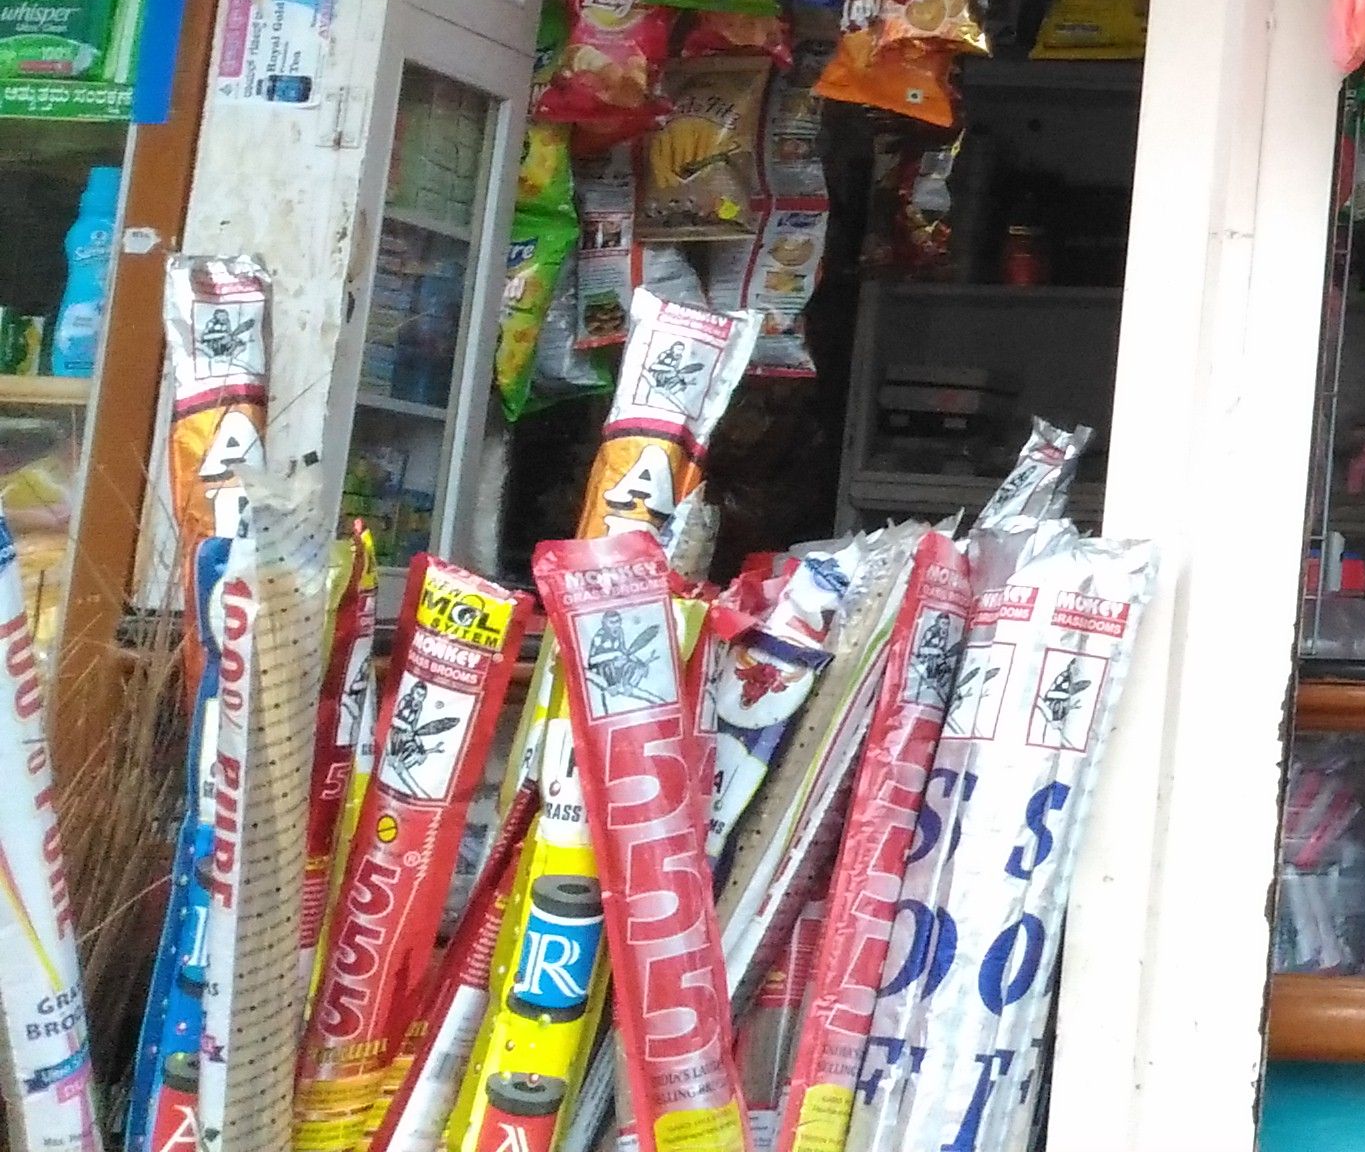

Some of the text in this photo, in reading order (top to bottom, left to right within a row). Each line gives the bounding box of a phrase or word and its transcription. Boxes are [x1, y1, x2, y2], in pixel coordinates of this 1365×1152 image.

[1, 1, 80, 24] whisper
[266, 1, 285, 74] Royal Gold
[289, 50, 302, 74] Tea
[430, 617, 499, 648] SYSTEM
[411, 631, 482, 668] MONKEY
[430, 660, 479, 685] BROOMS
[547, 802, 582, 823] RASS
[606, 714, 730, 1063] 555
[318, 854, 402, 1040] 555
